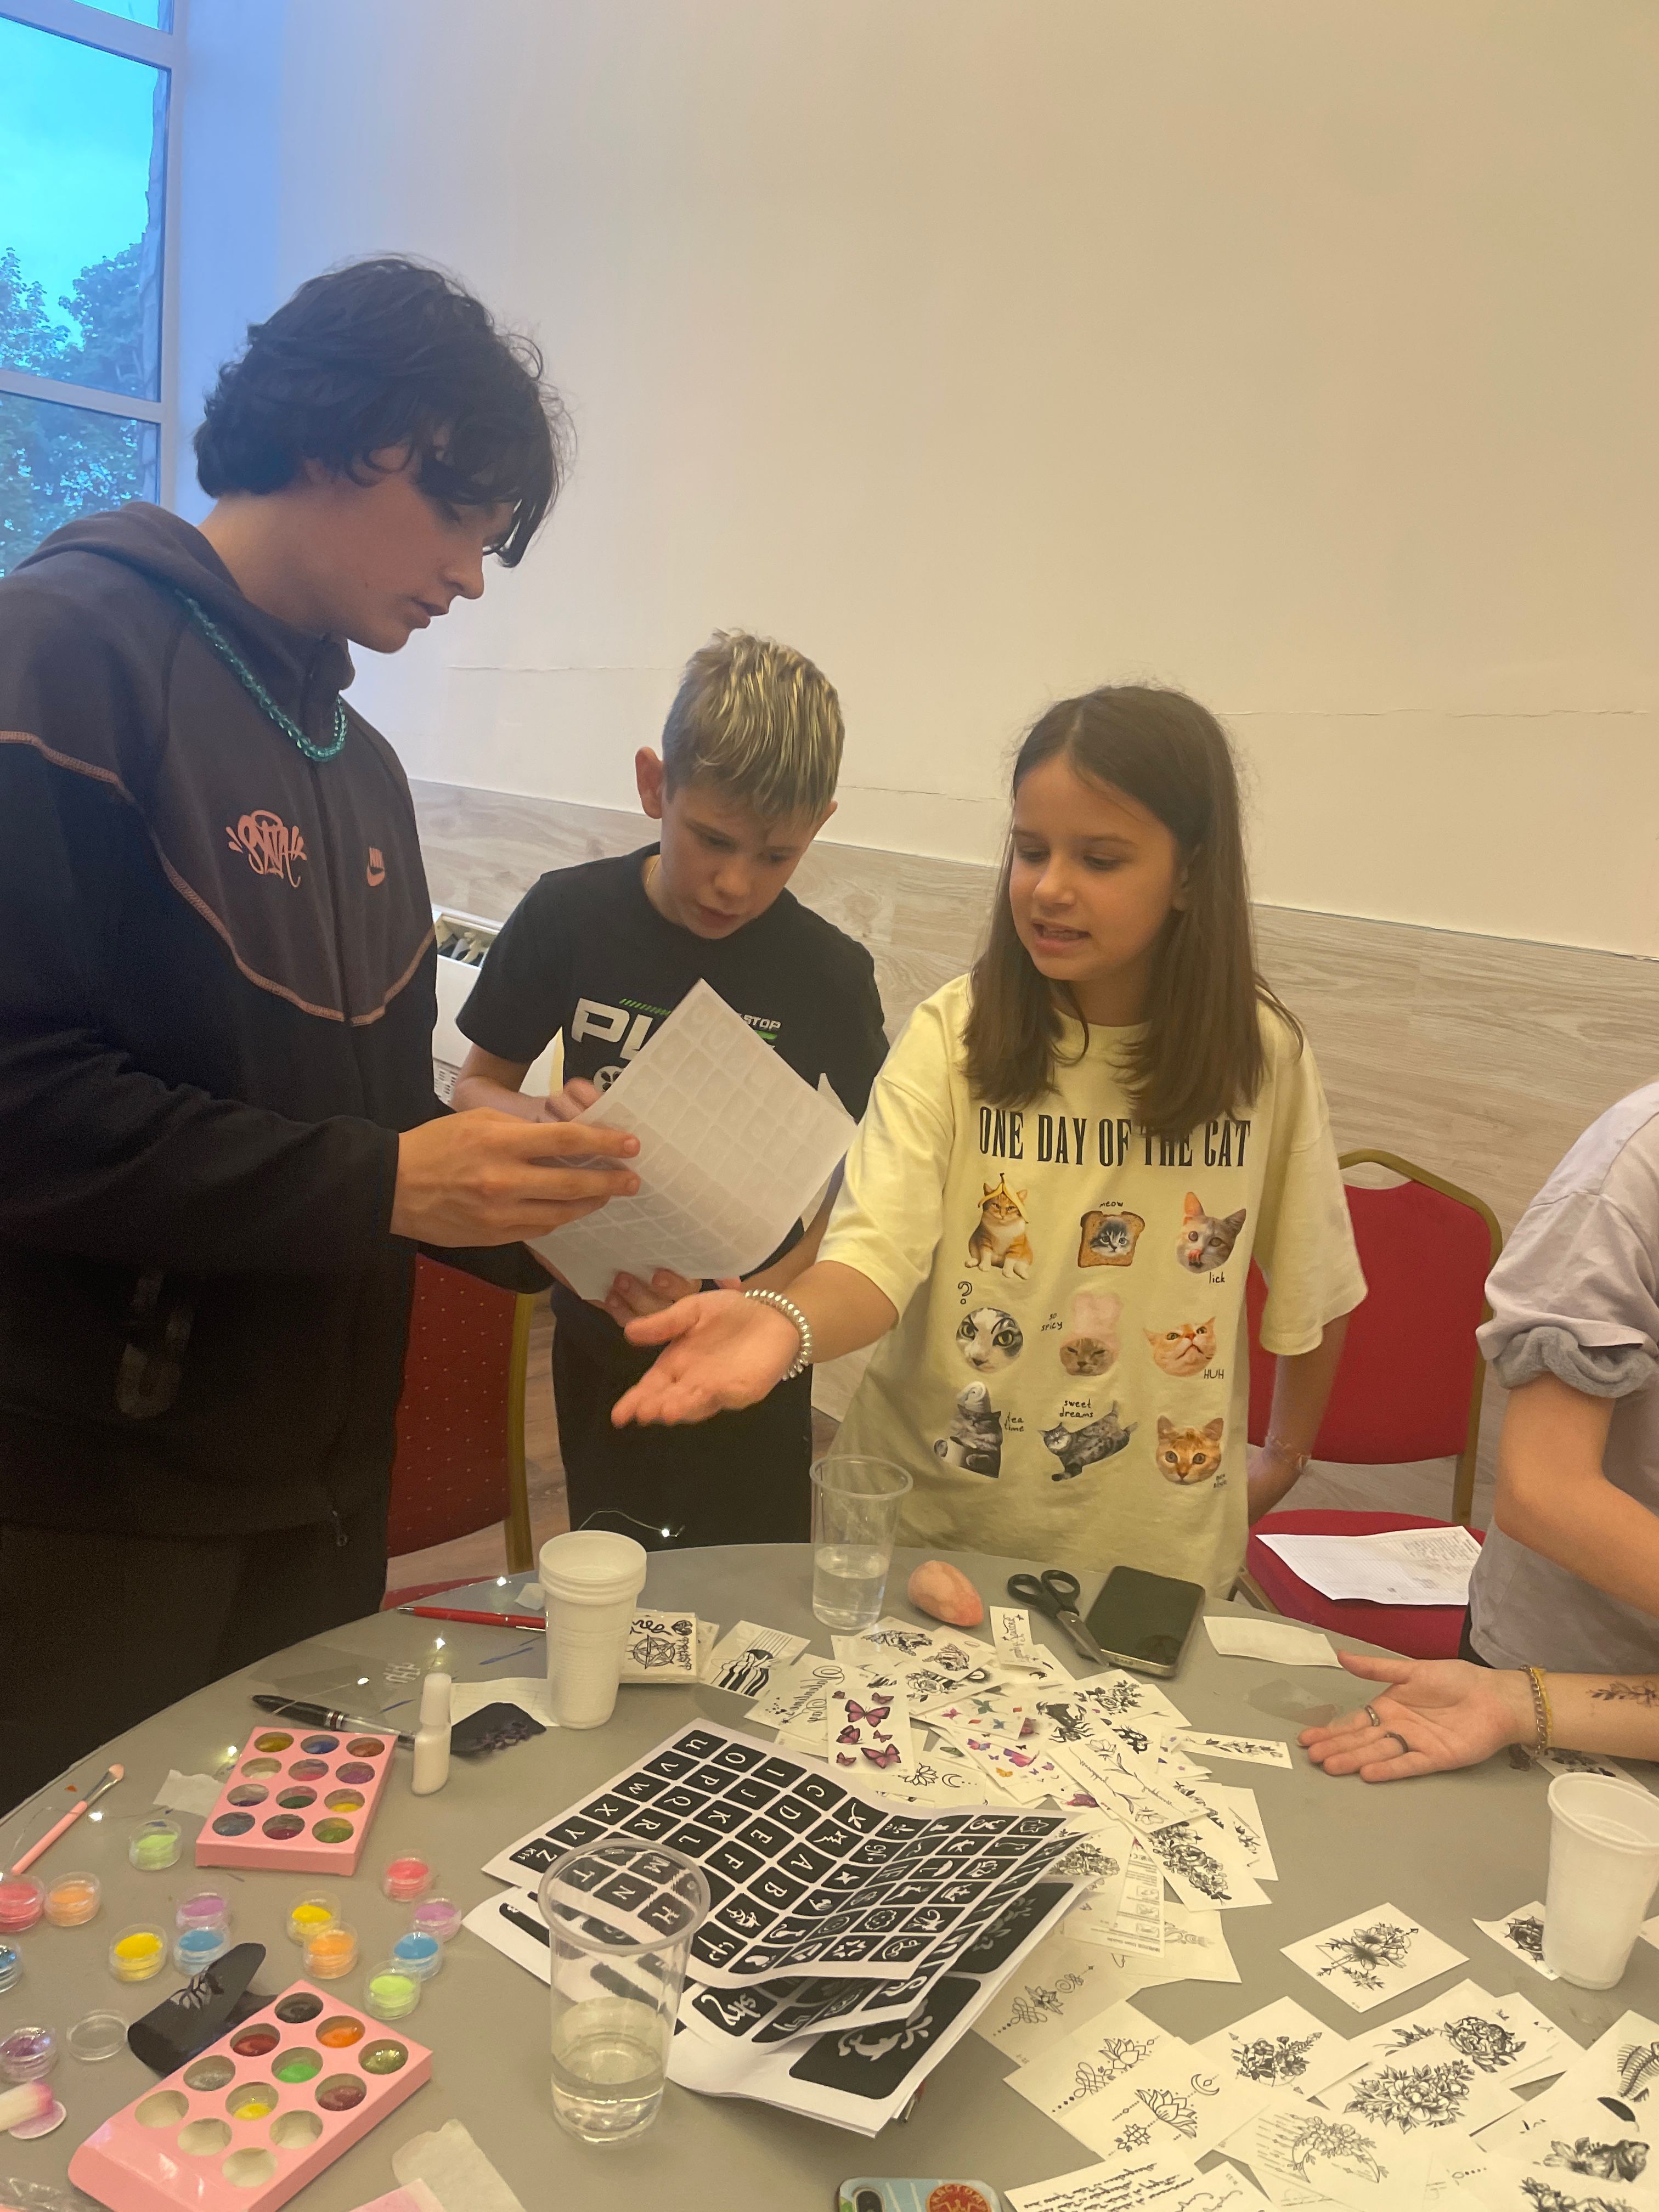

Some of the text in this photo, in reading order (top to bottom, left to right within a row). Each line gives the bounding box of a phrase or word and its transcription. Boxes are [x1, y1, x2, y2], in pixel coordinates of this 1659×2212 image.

[980, 1106, 1024, 1159] ONE
[1037, 1114, 1088, 1165] DAY
[1099, 1119, 1132, 1166] OF
[1205, 1120, 1251, 1167] CAT
[1209, 1272, 1225, 1284] lick
[957, 1281, 973, 1305] ?
[1203, 1369, 1224, 1379] HUH
[1064, 1398, 1092, 1408] sweet
[1006, 1412, 1024, 1423] tea
[1059, 1406, 1093, 1418] dreams
[1004, 1419, 1024, 1432] time
